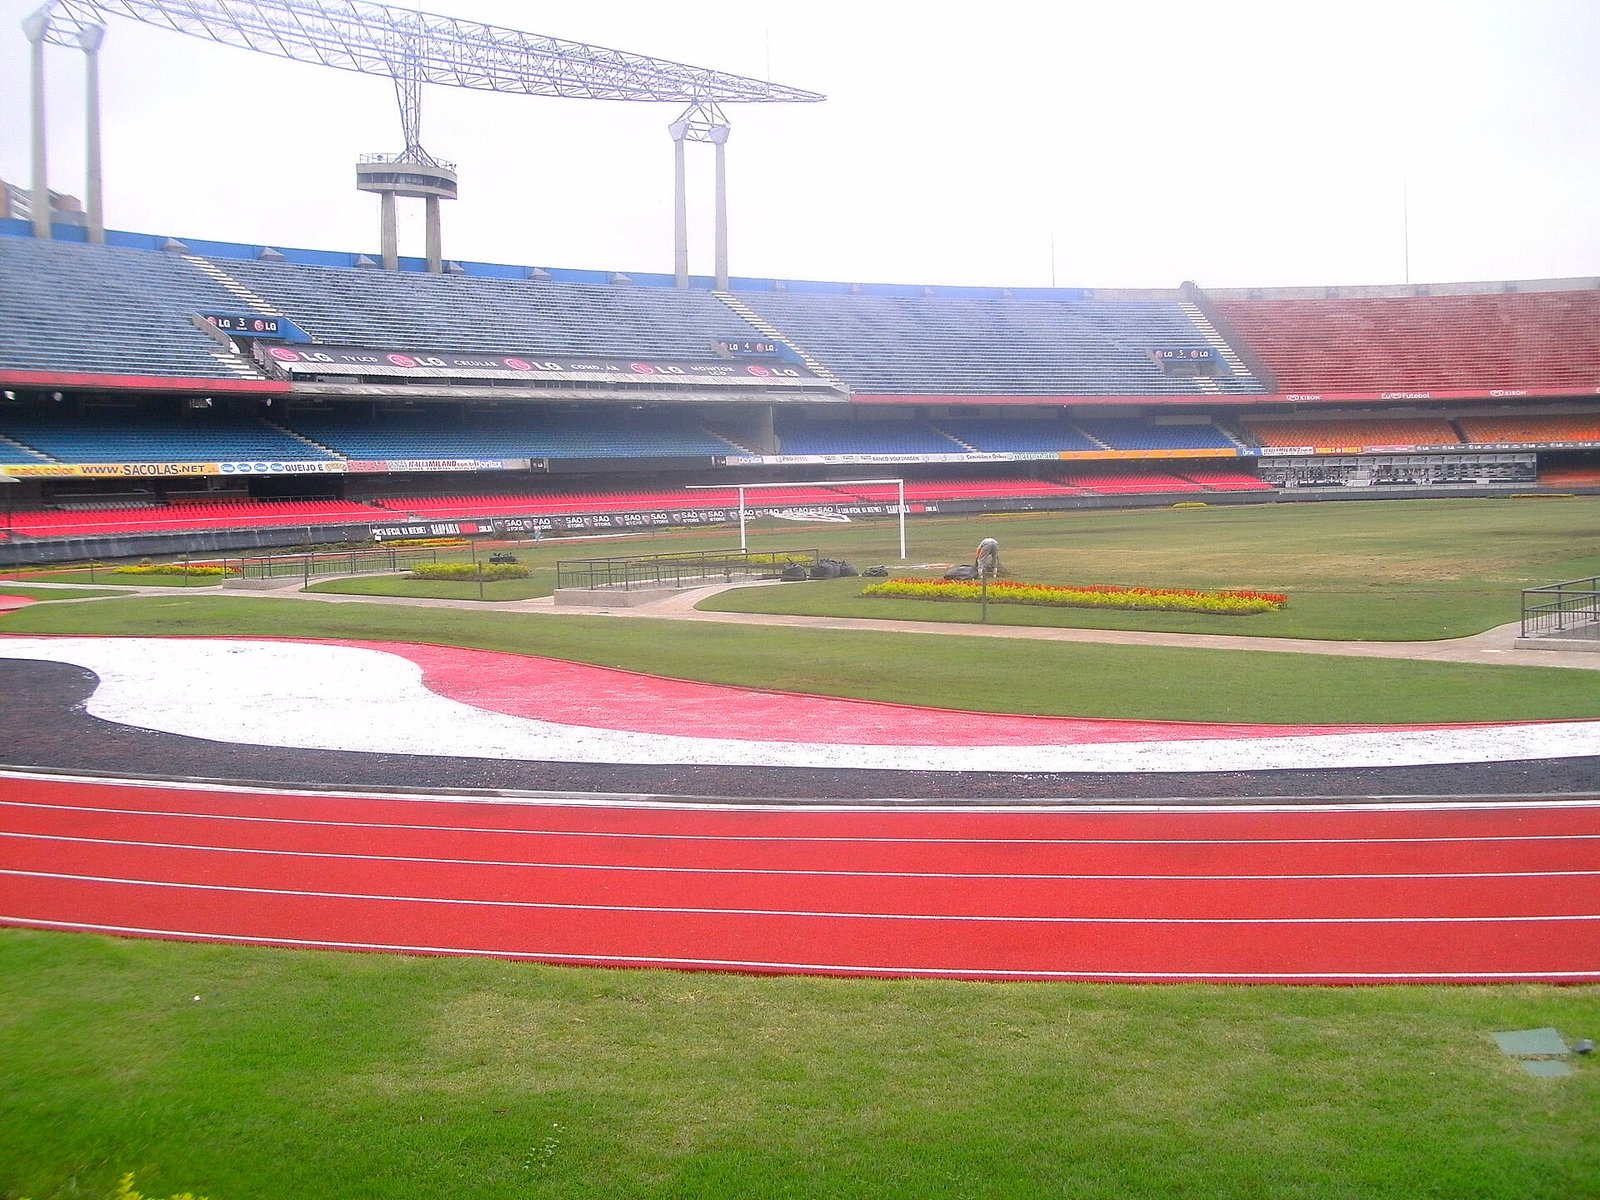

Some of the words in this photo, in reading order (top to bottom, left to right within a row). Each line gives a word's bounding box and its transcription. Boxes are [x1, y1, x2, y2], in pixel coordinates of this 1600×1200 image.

[218, 319, 231, 328] LG
[239, 318, 245, 326] 3
[265, 322, 277, 331] LG
[729, 343, 738, 351] LG
[299, 352, 335, 363] LG
[414, 356, 448, 367] LG
[453, 360, 500, 368] CELULAR
[532, 361, 565, 371] LG
[655, 366, 686, 375] LG
[771, 368, 800, 378] LG
[285, 464, 316, 472] QUEIJO
